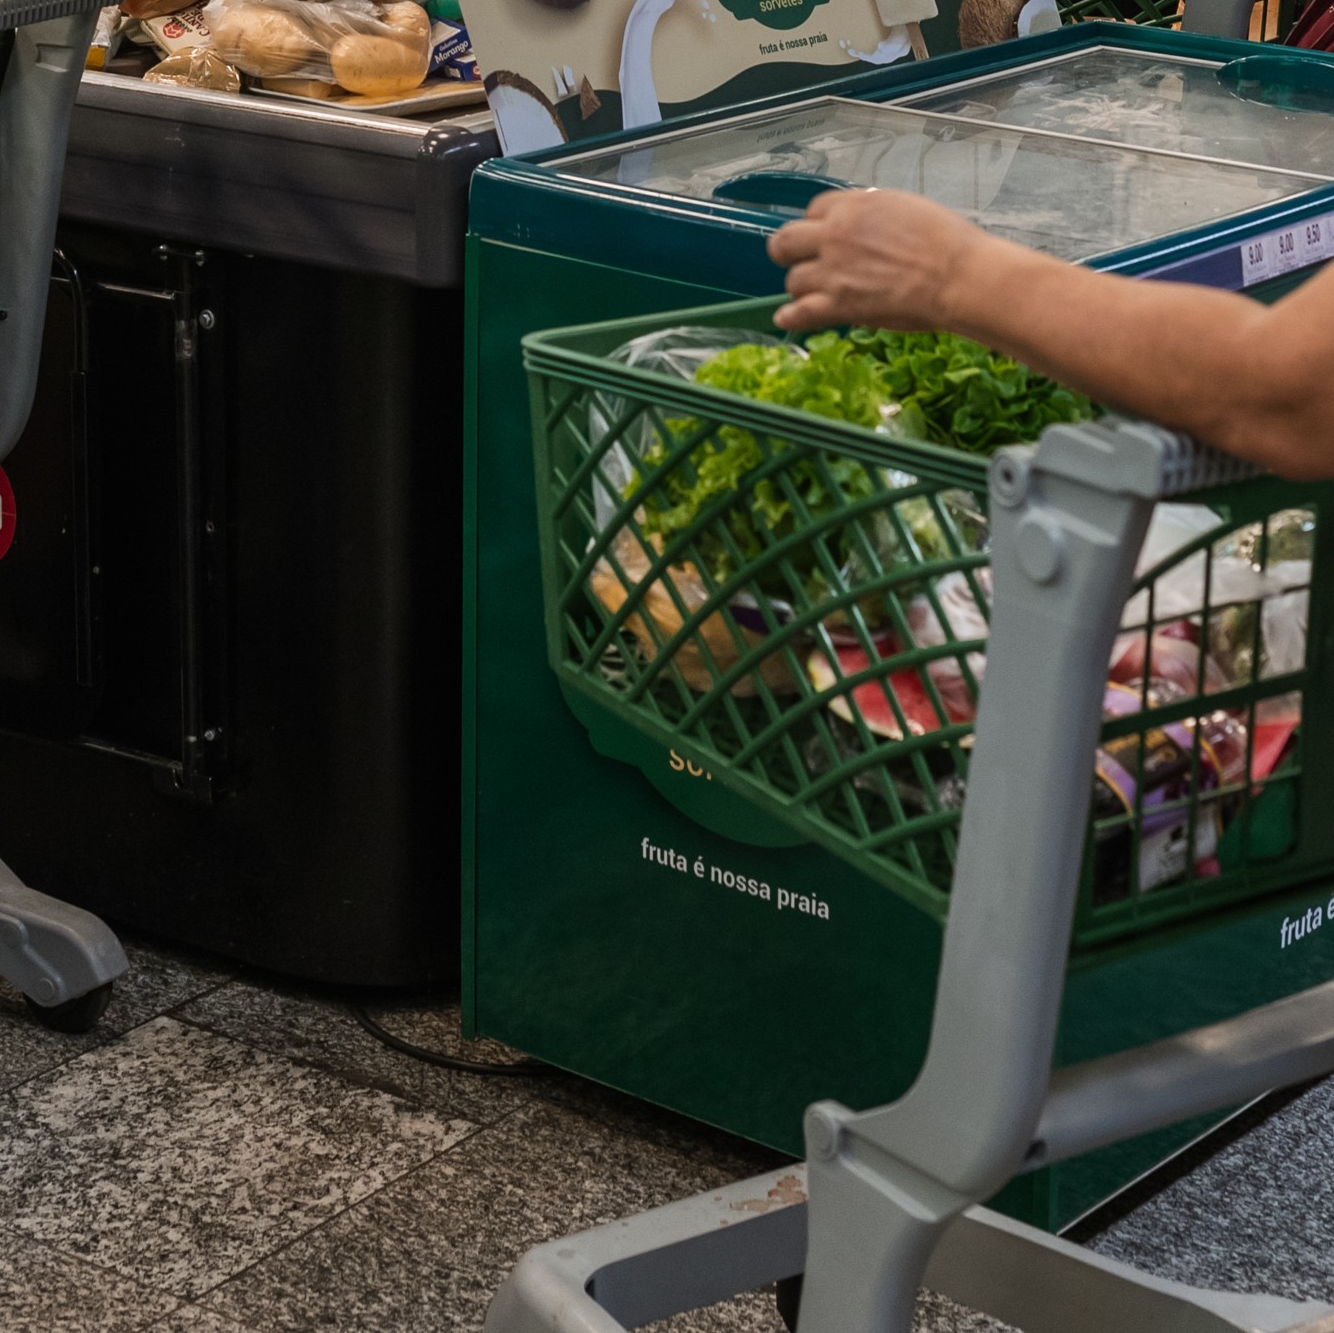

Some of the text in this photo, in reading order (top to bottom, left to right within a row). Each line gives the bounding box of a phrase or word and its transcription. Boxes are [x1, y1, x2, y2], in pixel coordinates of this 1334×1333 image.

[434, 40, 469, 64] Morango
[759, 31, 829, 55] fruta é nossa praia
[641, 837, 830, 920] fruta é nossa praia
[1280, 916, 1323, 949] fruta
